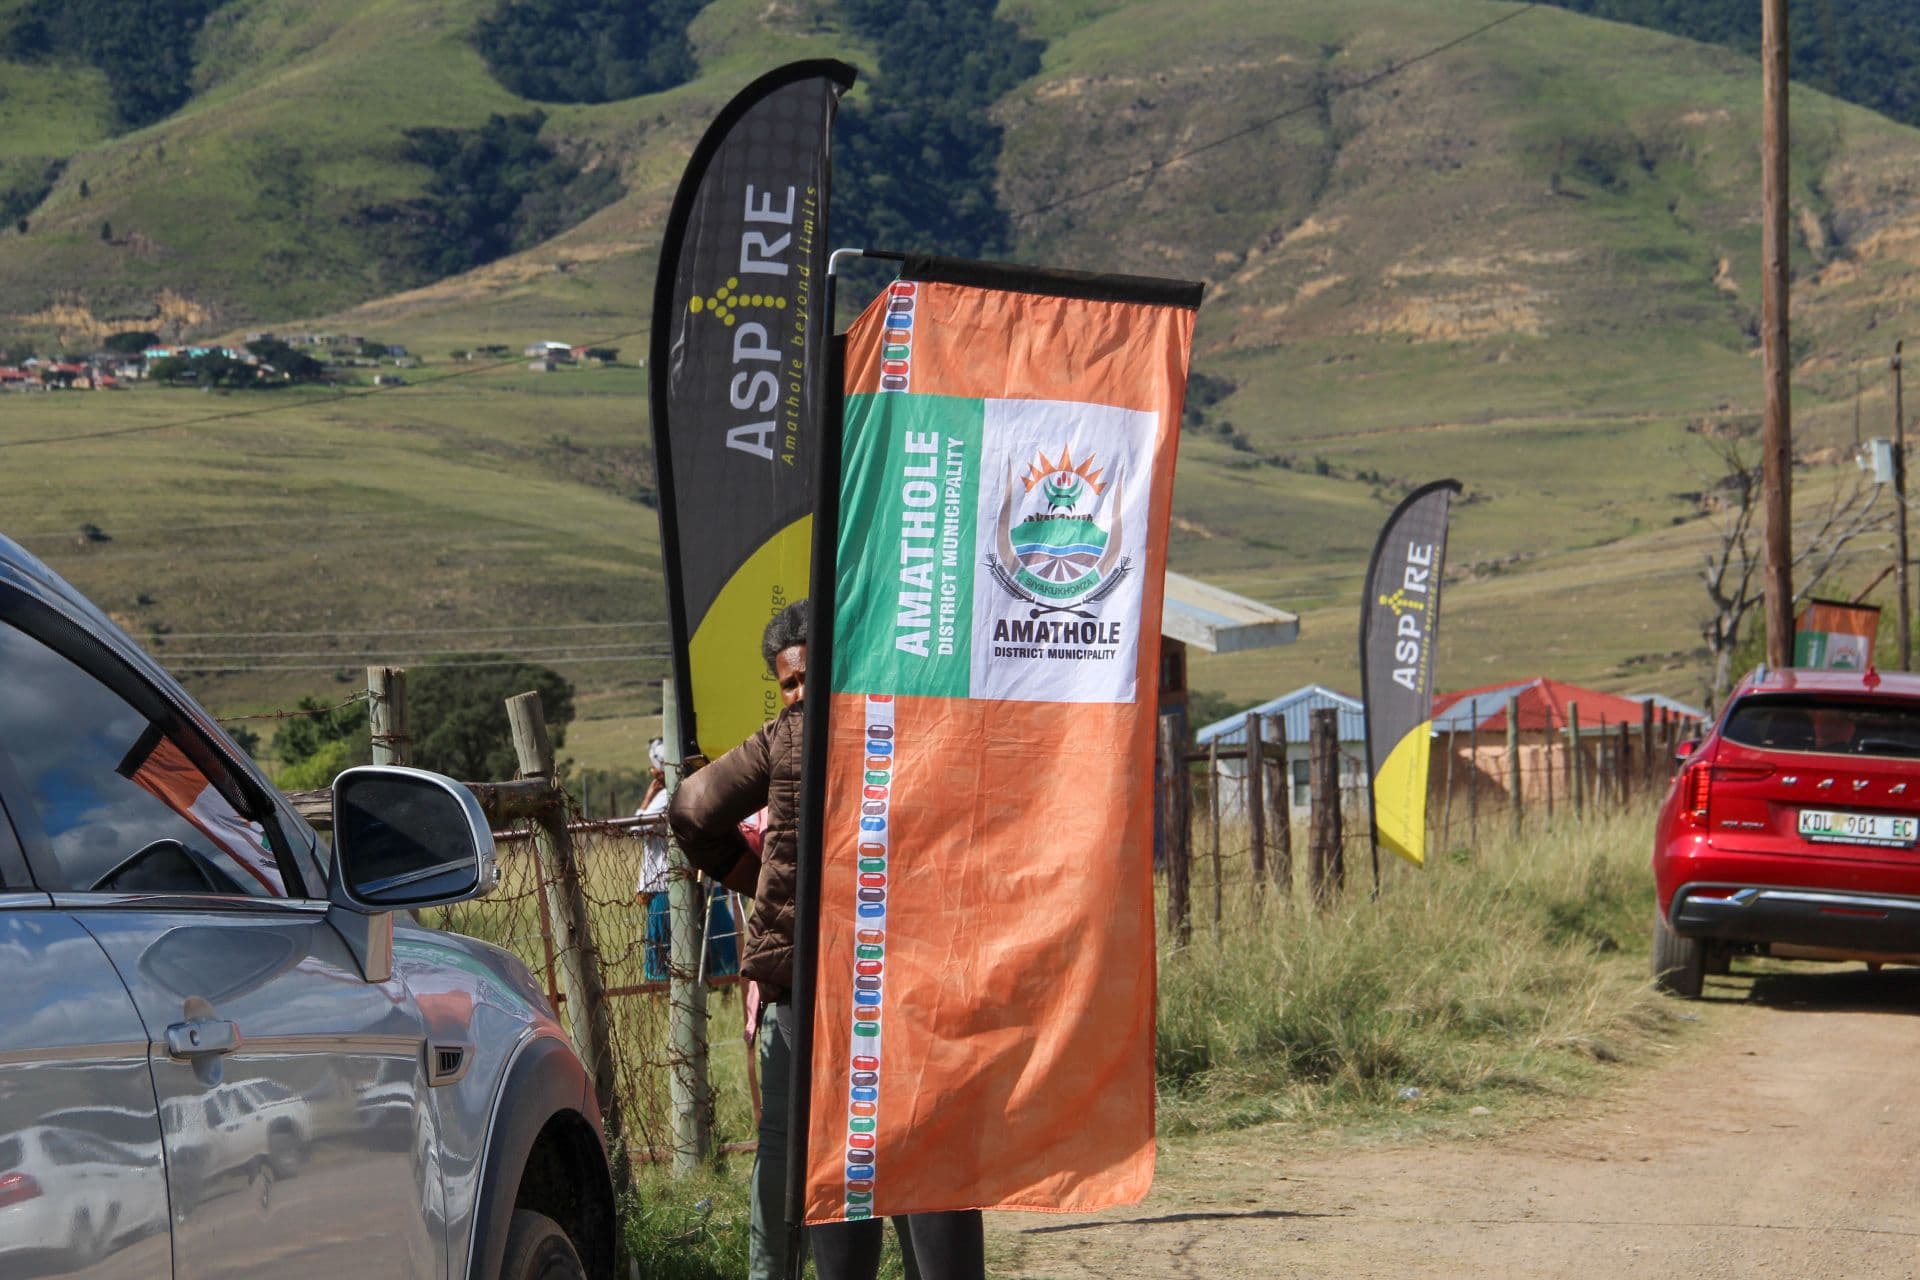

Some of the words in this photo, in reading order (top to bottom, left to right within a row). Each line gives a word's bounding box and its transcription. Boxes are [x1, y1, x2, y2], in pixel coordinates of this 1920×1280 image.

[798, 186, 817, 253] limits
[790, 265, 811, 346] beyond
[781, 360, 803, 465] Amathole
[942, 437, 964, 566] MUNICIPALITY
[895, 431, 940, 658] AMATHOLE
[938, 572, 957, 656] DISTRICT
[1025, 577, 1093, 596] SIYAKUKHONZA
[993, 618, 1121, 645] AMATHOLE
[995, 646, 1044, 659] DISTRICT
[1047, 648, 1116, 661] MUNICIPALITY
[1801, 813, 1833, 832] KDL
[1847, 816, 1877, 836] 901
[1892, 819, 1912, 838] EC
